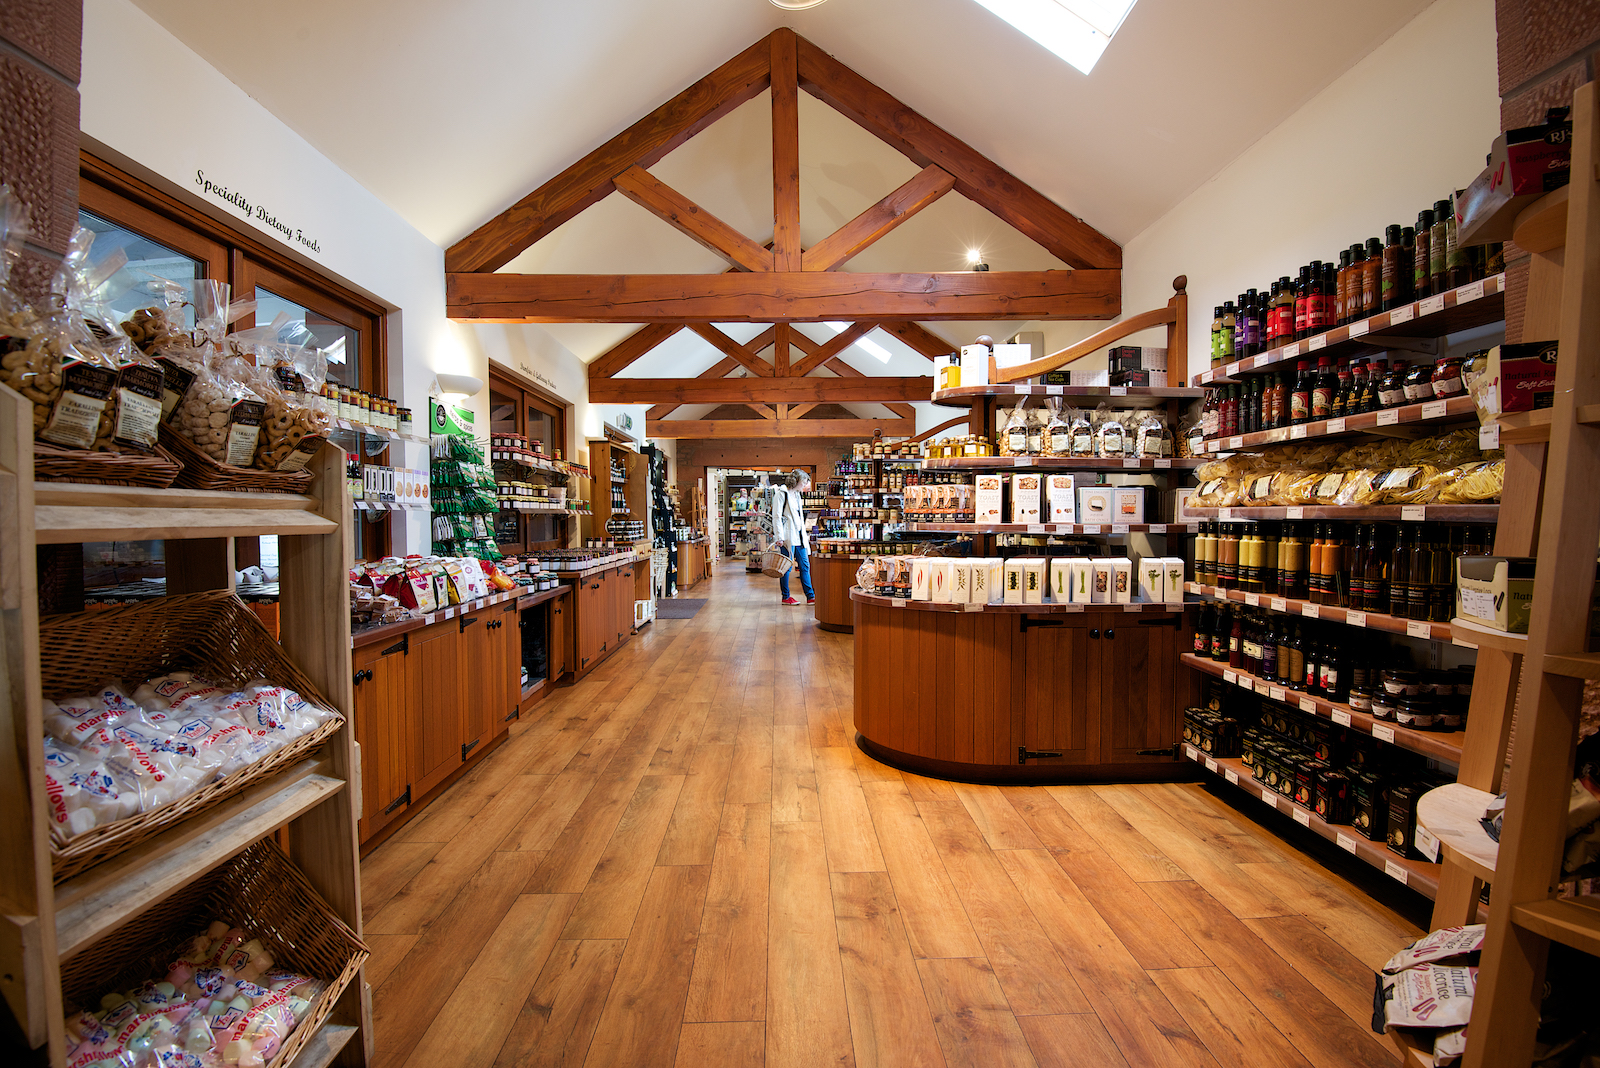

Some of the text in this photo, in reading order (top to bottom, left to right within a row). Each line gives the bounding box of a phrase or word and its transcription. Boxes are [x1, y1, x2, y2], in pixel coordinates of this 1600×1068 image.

[1515, 150, 1566, 164] Raspberry
[195, 169, 321, 253] Speciality Dietary Foods
[46, 774, 68, 823] allows
